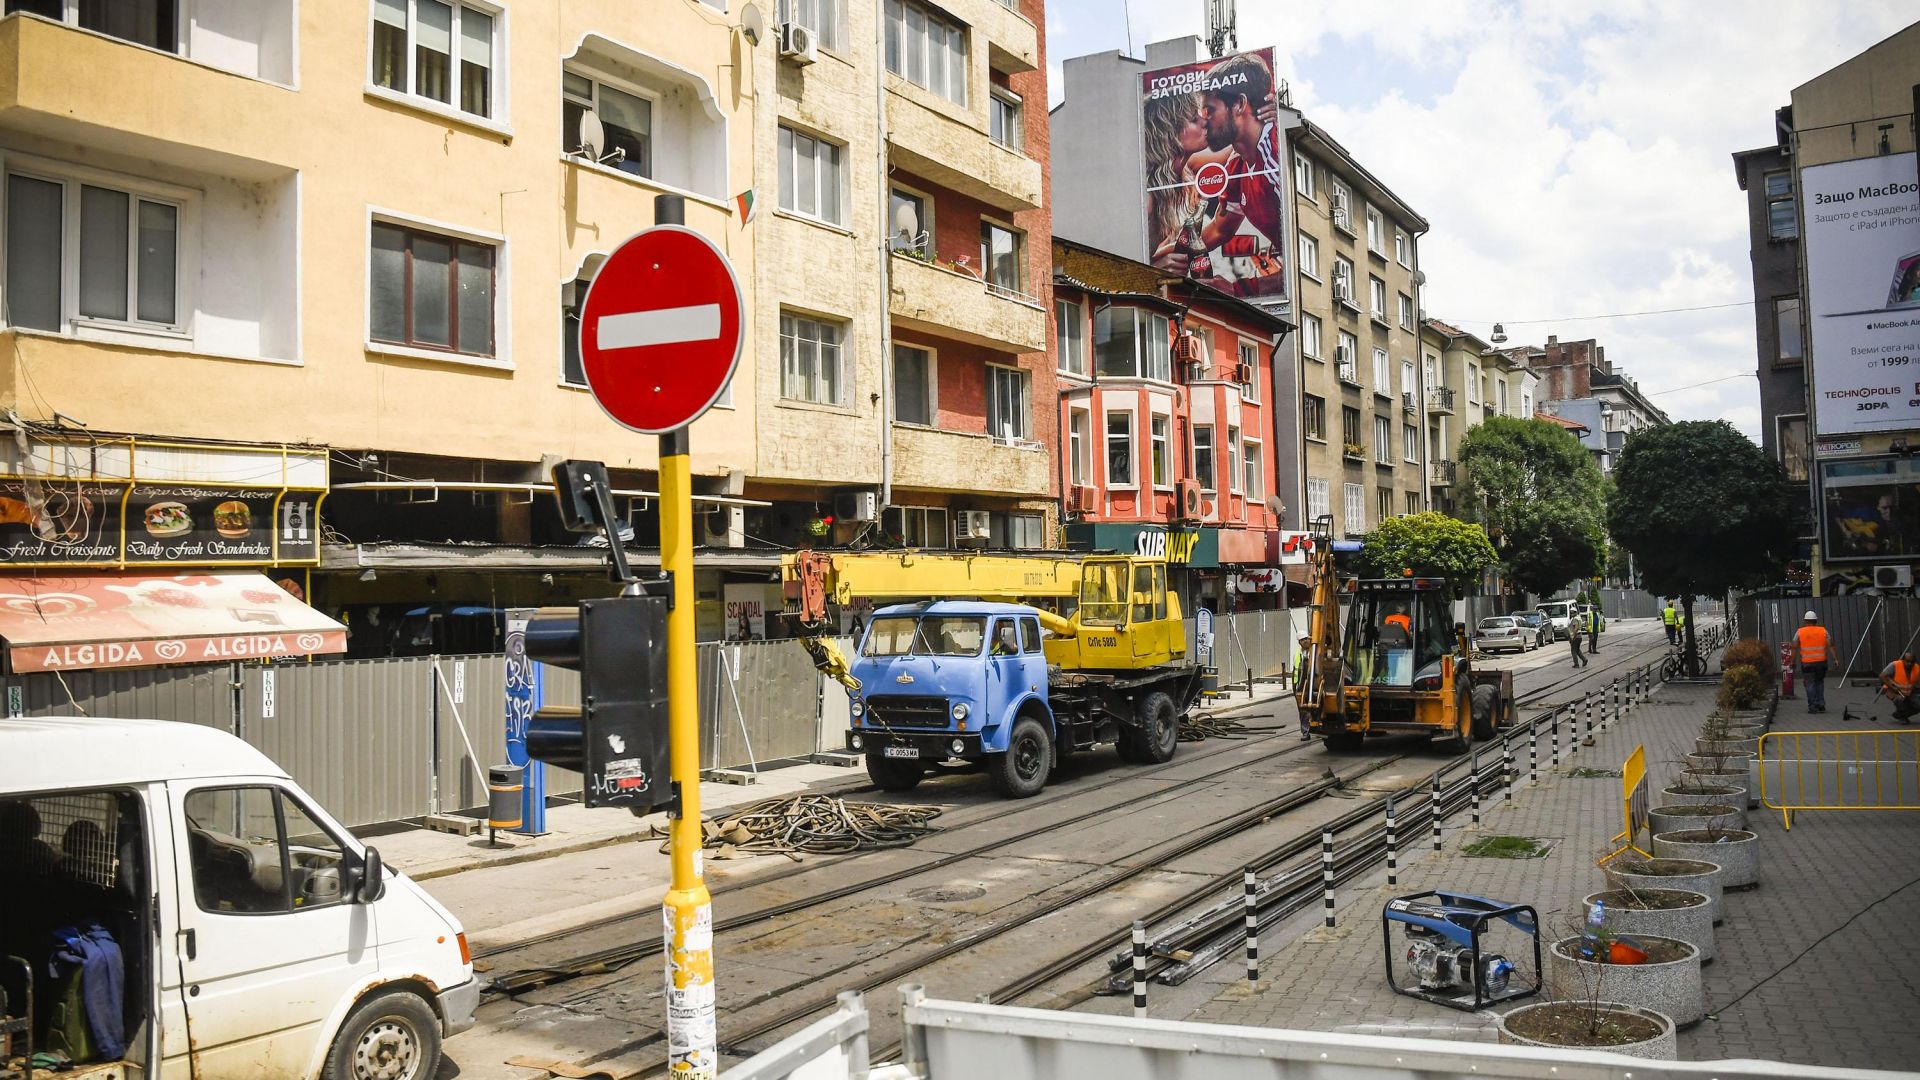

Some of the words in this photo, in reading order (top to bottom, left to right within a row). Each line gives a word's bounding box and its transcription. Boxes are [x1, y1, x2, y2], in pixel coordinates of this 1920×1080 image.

[1151, 70, 1205, 89] ГОТОВИ
[1151, 88, 1170, 100] ЗА
[1173, 72, 1248, 96] ПОБЕДАТА
[1815, 192, 1855, 205] Защо
[1859, 183, 1918, 199] MacBoo
[1814, 212, 1851, 224] Защото
[1852, 211, 1859, 219] е
[1861, 204, 1908, 218] създаден
[1857, 220, 1878, 231] iPad
[1873, 320, 1908, 330] MacBook
[1851, 346, 1879, 355] Вземи
[1881, 344, 1901, 353] сега
[1903, 343, 1915, 351] на
[1881, 356, 1909, 367] 1999
[1825, 386, 1901, 399] TECHNOPOLIS
[1856, 402, 1890, 411] ЗОРА
[0, 541, 46, 560] Fresh
[51, 541, 116, 557] Croissants
[127, 541, 164, 560] Daily
[166, 542, 203, 560] Fresh
[207, 541, 271, 557] Sandwiches
[1137, 530, 1199, 563] SUBWAY
[727, 600, 763, 619] SCANDAL
[43, 643, 143, 667] ALGIDA
[204, 635, 287, 657] ALGIDA
[1102, 637, 1117, 647] 5883
